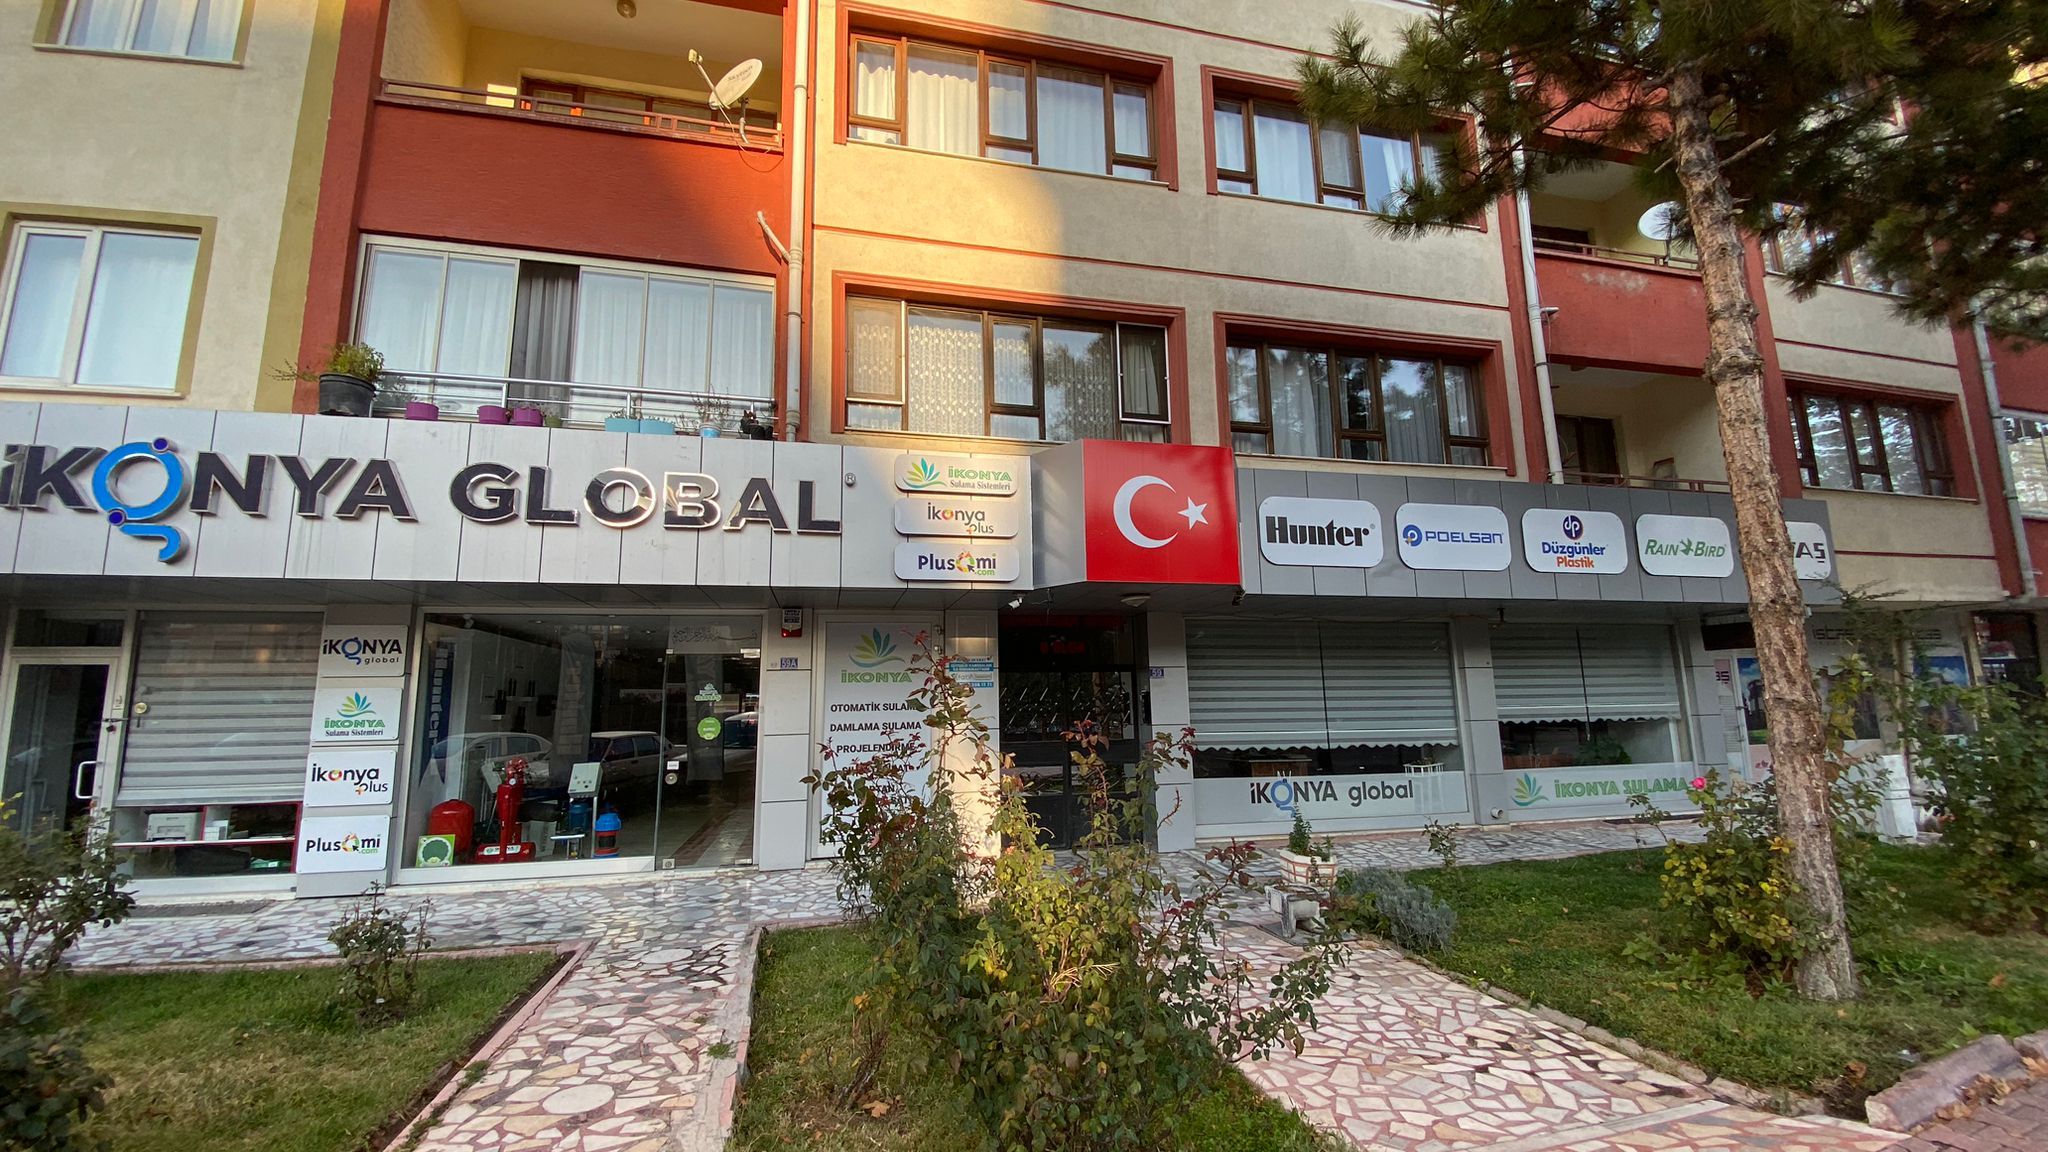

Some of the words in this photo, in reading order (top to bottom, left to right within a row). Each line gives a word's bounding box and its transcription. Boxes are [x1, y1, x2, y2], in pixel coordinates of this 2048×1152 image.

[950, 479, 976, 489] Sulama
[977, 481, 1011, 490] Sistemleri
[449, 461, 842, 535] GLOBAL
[966, 521, 994, 535] plus
[1266, 515, 1370, 547] Hunter
[1542, 541, 1606, 558] Düzgünler
[1556, 556, 1595, 568] Plastik
[364, 657, 399, 665] global
[782, 657, 798, 668] 59A
[1151, 669, 1163, 678] 59
[830, 702, 881, 712] OTOMATİK
[325, 729, 349, 737] Sulama
[351, 728, 384, 736] Sistemleri
[830, 722, 880, 732] DAMLAMA
[882, 721, 922, 731] SULAMA
[355, 781, 388, 795] plus
[1623, 776, 1689, 795] SULAMA
[1348, 780, 1414, 807] global
